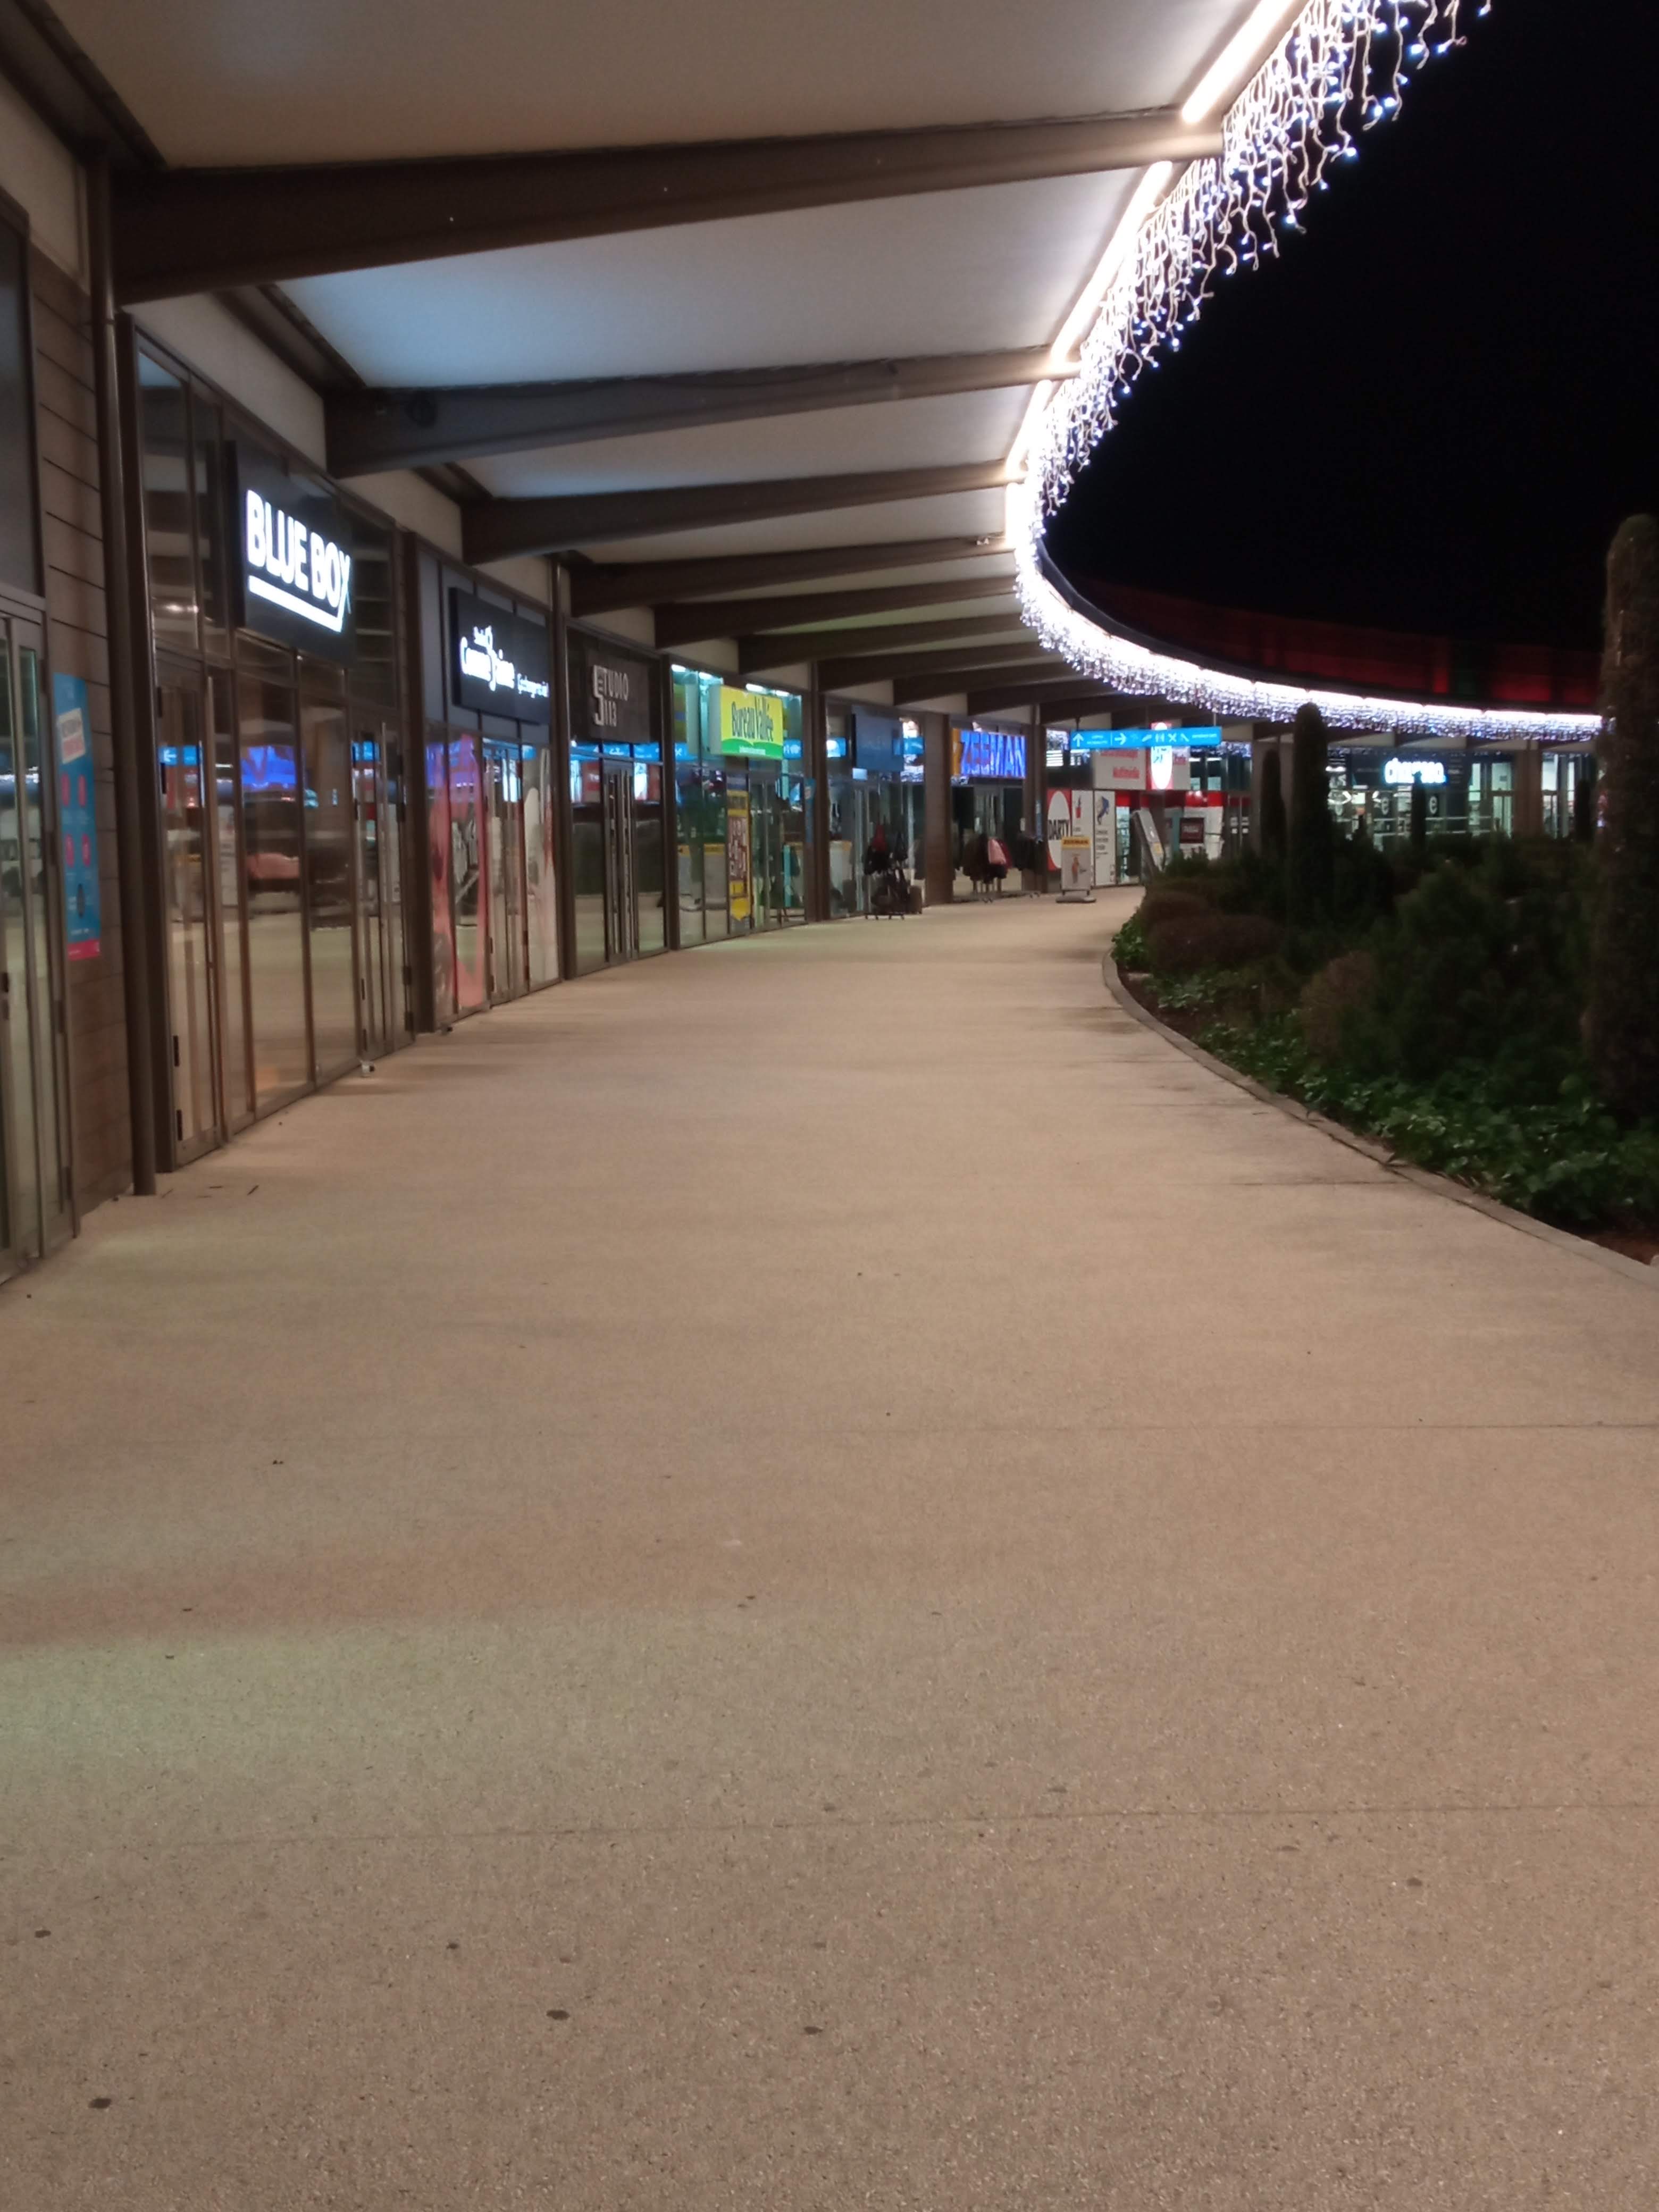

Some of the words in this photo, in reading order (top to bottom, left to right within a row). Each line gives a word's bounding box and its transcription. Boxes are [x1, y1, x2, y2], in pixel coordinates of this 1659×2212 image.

[247, 489, 308, 592] BLUE
[311, 532, 351, 616] BOX
[731, 700, 755, 739] Bureau
[754, 696, 774, 742] Vallée
[961, 730, 1026, 778] ZEEMAN
